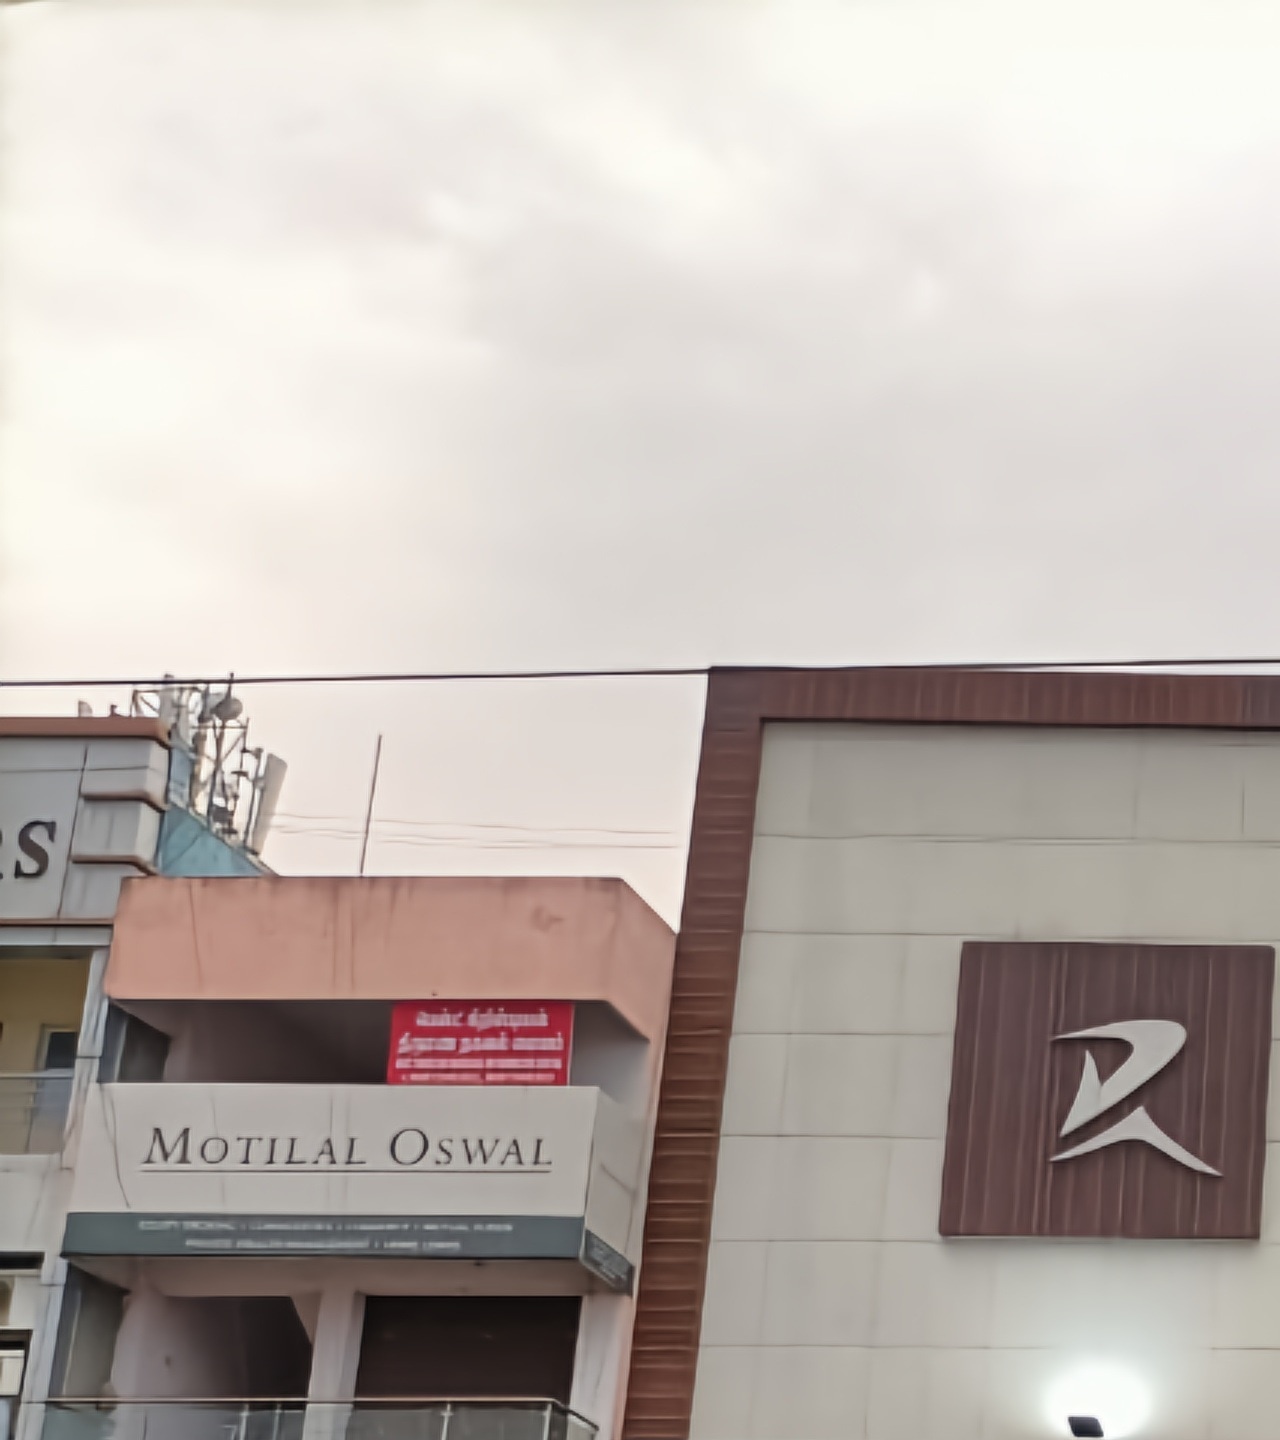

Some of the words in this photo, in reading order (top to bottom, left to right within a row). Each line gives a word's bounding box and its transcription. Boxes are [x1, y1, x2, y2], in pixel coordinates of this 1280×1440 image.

[0, 819, 57, 879] S
[140, 1127, 368, 1167] MOTILAL
[389, 1127, 553, 1167] OSWAL
